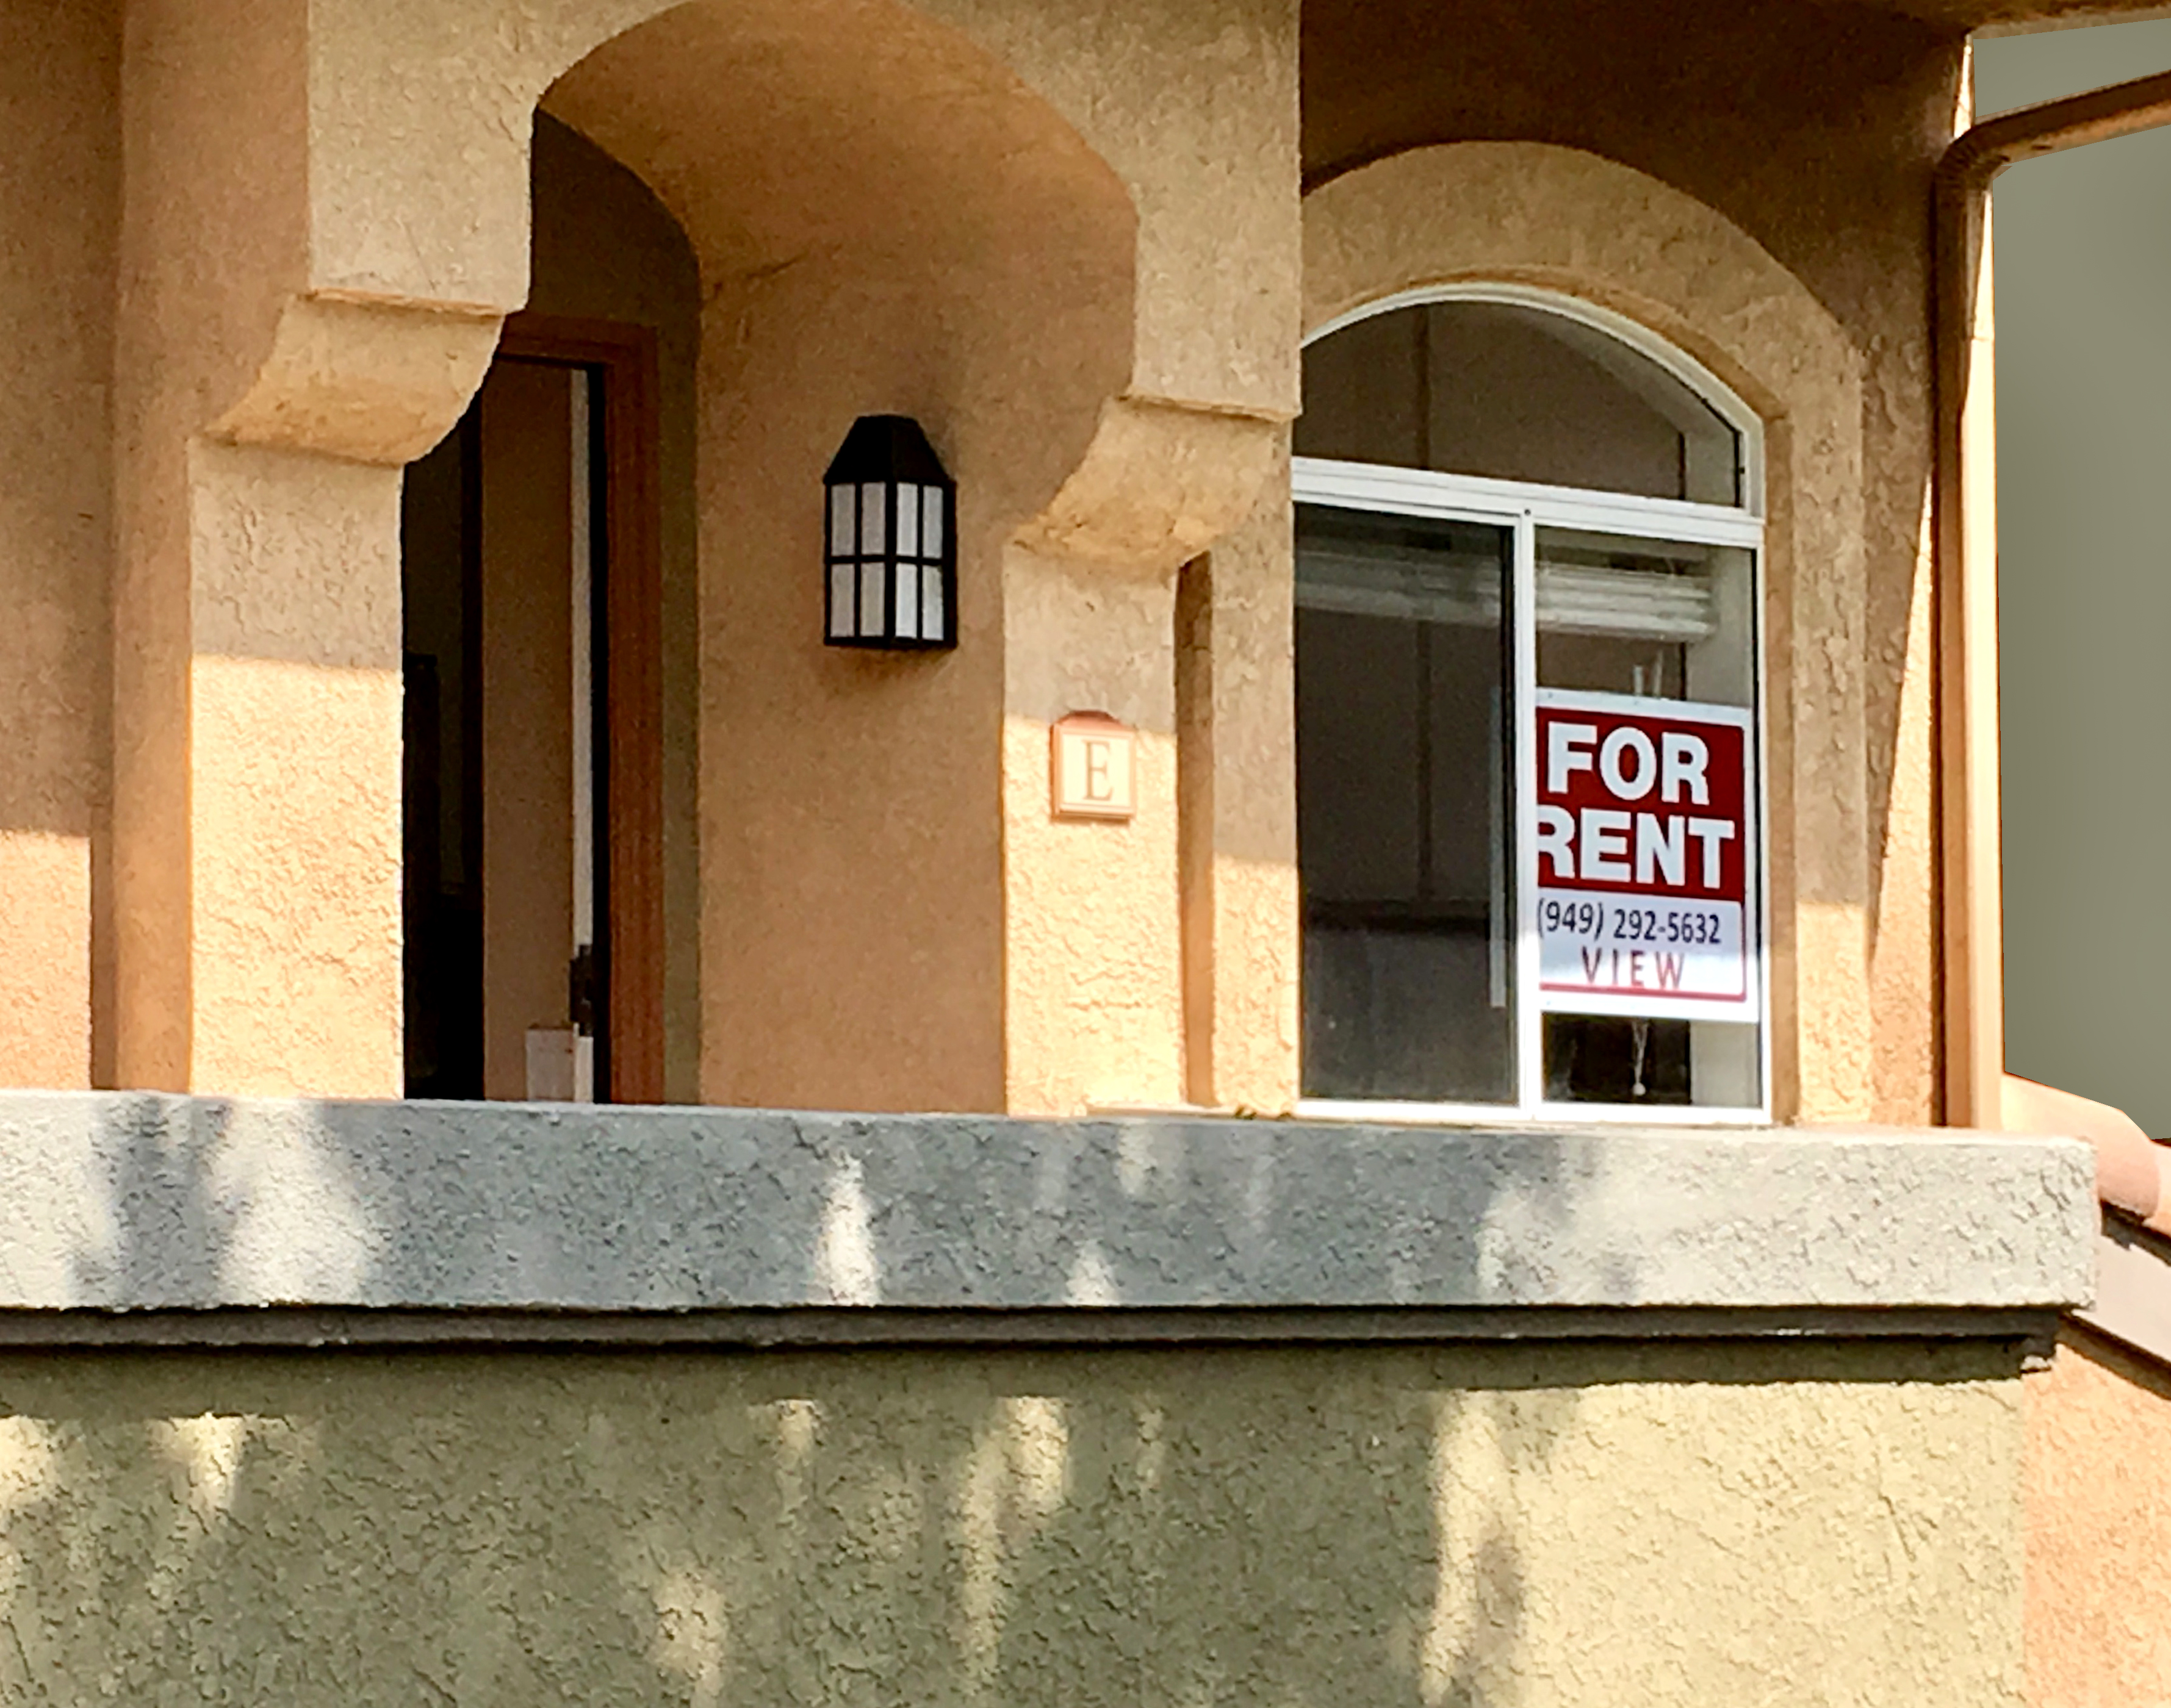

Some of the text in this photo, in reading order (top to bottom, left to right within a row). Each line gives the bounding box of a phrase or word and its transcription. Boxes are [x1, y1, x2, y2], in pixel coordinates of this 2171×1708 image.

[1082, 739, 1114, 801] E
[1547, 721, 1709, 805] FOR
[1537, 805, 1735, 889] RENT
[1538, 899, 1721, 944] (949) 292-5632
[1582, 947, 1684, 989] VIEW
